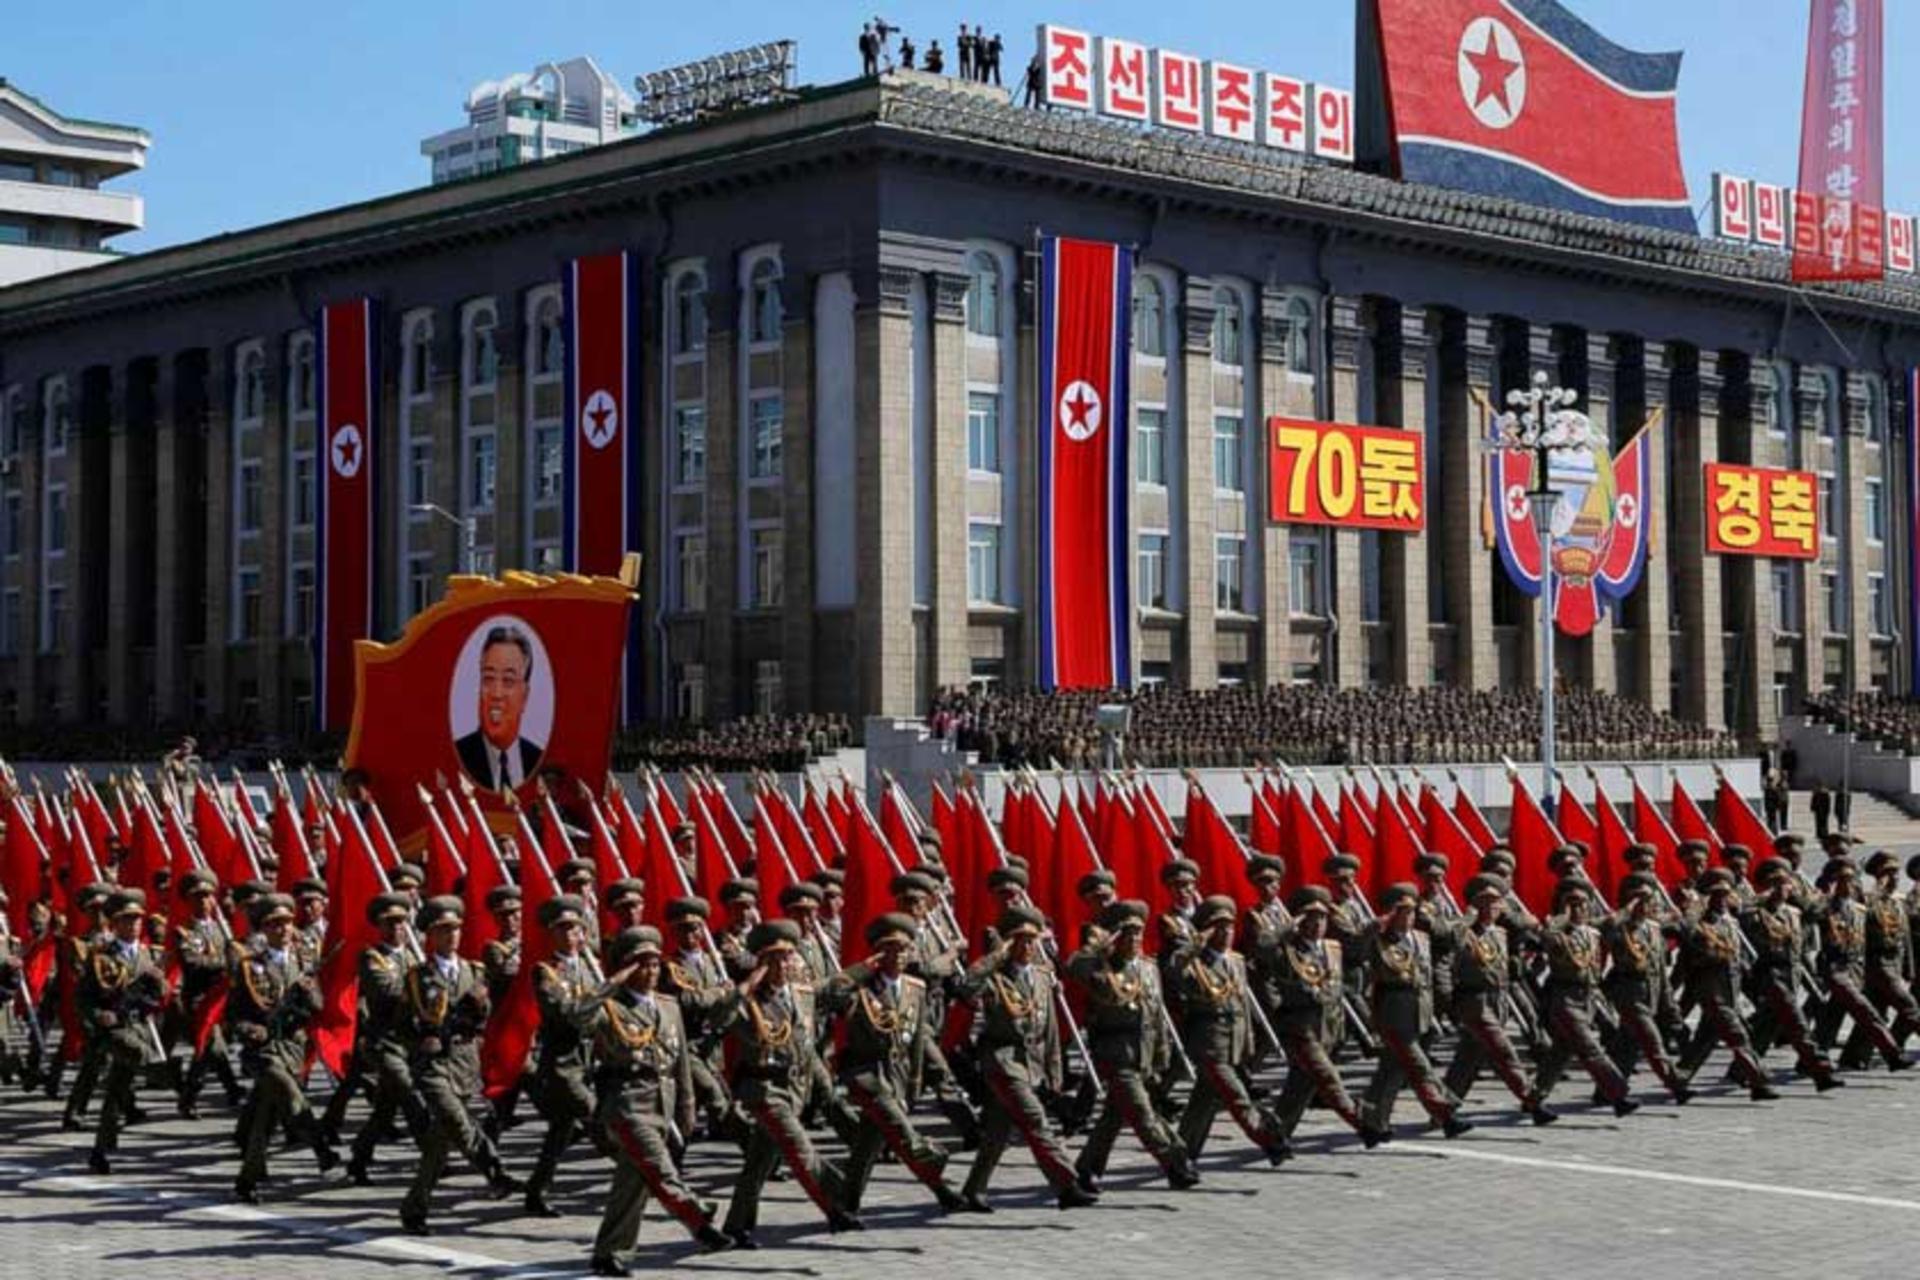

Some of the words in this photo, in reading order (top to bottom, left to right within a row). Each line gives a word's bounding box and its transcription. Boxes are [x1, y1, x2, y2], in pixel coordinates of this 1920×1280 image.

[1052, 31, 1350, 155] 조선민주주의
[1279, 427, 1420, 519] 70돐
[1716, 472, 1815, 550] 경축
